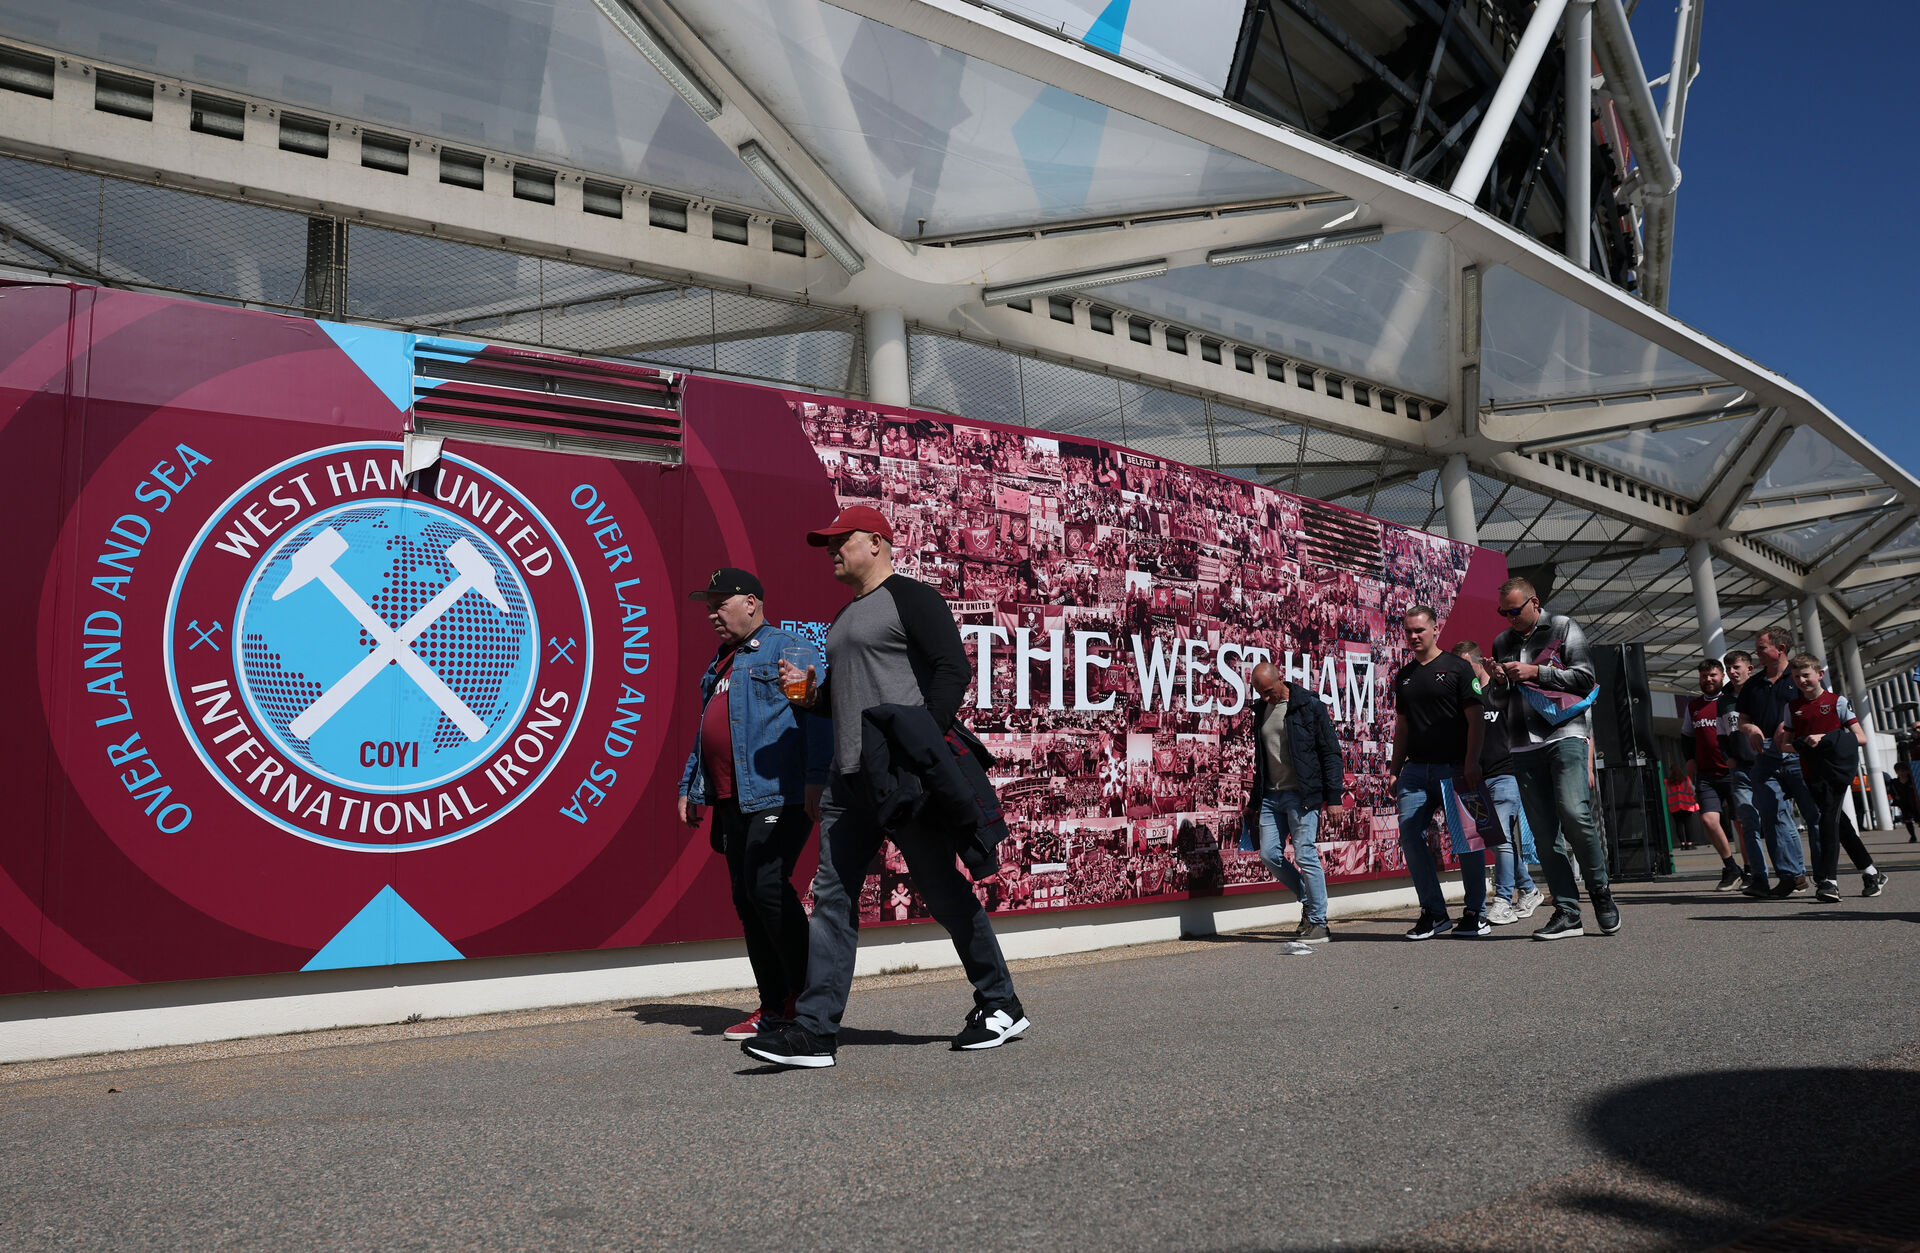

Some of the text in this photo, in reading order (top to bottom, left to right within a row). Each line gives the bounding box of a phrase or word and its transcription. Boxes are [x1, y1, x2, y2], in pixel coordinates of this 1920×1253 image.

[1126, 455, 1156, 469] BELFAST
[215, 473, 316, 558] WEST
[434, 468, 553, 577] UNITED
[84, 444, 212, 833] OVER LAND AND SEA
[559, 484, 649, 824] OVER LAND AND SEA
[965, 602, 990, 611] UNITED
[960, 624, 1376, 724] THE WEST HAM
[1483, 710, 1500, 723] ay
[192, 680, 568, 834] INTERNATIONAL IRONS
[359, 741, 419, 768] COYI
